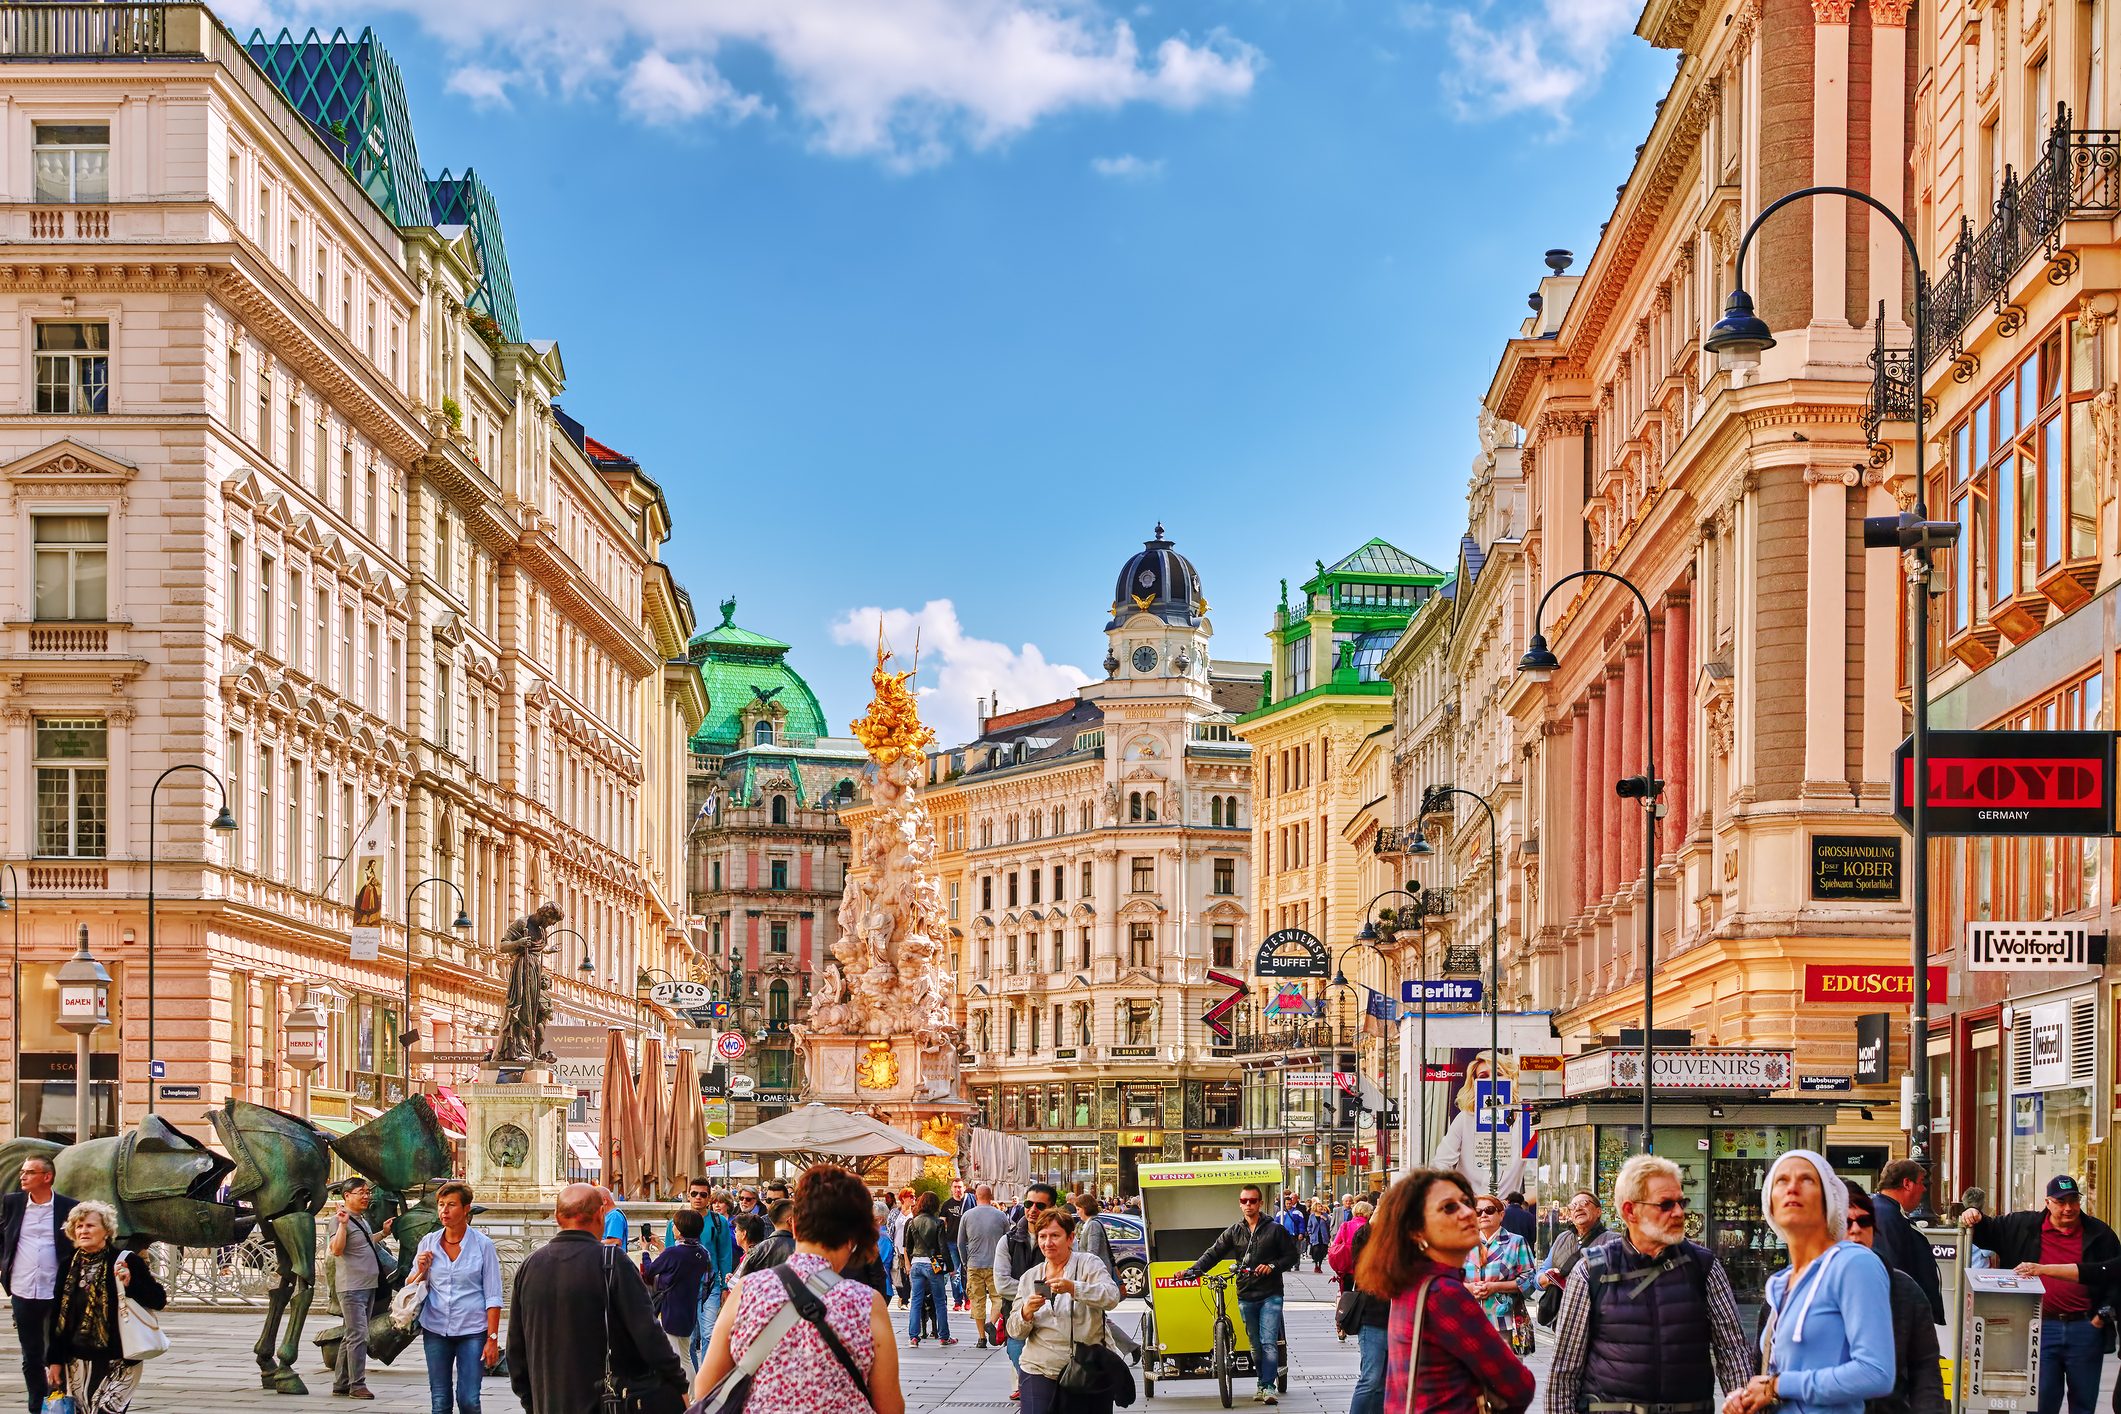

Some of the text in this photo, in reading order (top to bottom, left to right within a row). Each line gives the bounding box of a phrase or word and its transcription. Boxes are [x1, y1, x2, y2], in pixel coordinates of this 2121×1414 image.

[1978, 811, 2030, 820] GERMANY
[1818, 846, 1895, 858] GROSSHANDLUNG
[1844, 861, 1893, 876] KOBER
[1820, 878, 1854, 890] Spielwaren
[1260, 932, 1326, 965] TRZESNIEWSKI
[1993, 939, 2066, 954] Wolford
[1273, 958, 1312, 967] BUFFET
[1822, 974, 1931, 993] EDUSCH
[657, 984, 705, 997] ZIKOS
[1411, 983, 1473, 998] Berlitz
[1859, 1047, 1875, 1060] MONT
[1641, 1059, 1761, 1075] OUVENIRS
[1859, 1060, 1876, 1073] BLANC
[763, 1094, 796, 1102] OMEGA
[1196, 1170, 1270, 1179] SIGHTSEEING
[1932, 1245, 1956, 1257] ÖVP
[1157, 1277, 1200, 1287] VIENNA
[1972, 1322, 1982, 1395] GRATIS
[2030, 1323, 2040, 1396] GRATIS
[1990, 1399, 2017, 1408] 0818
